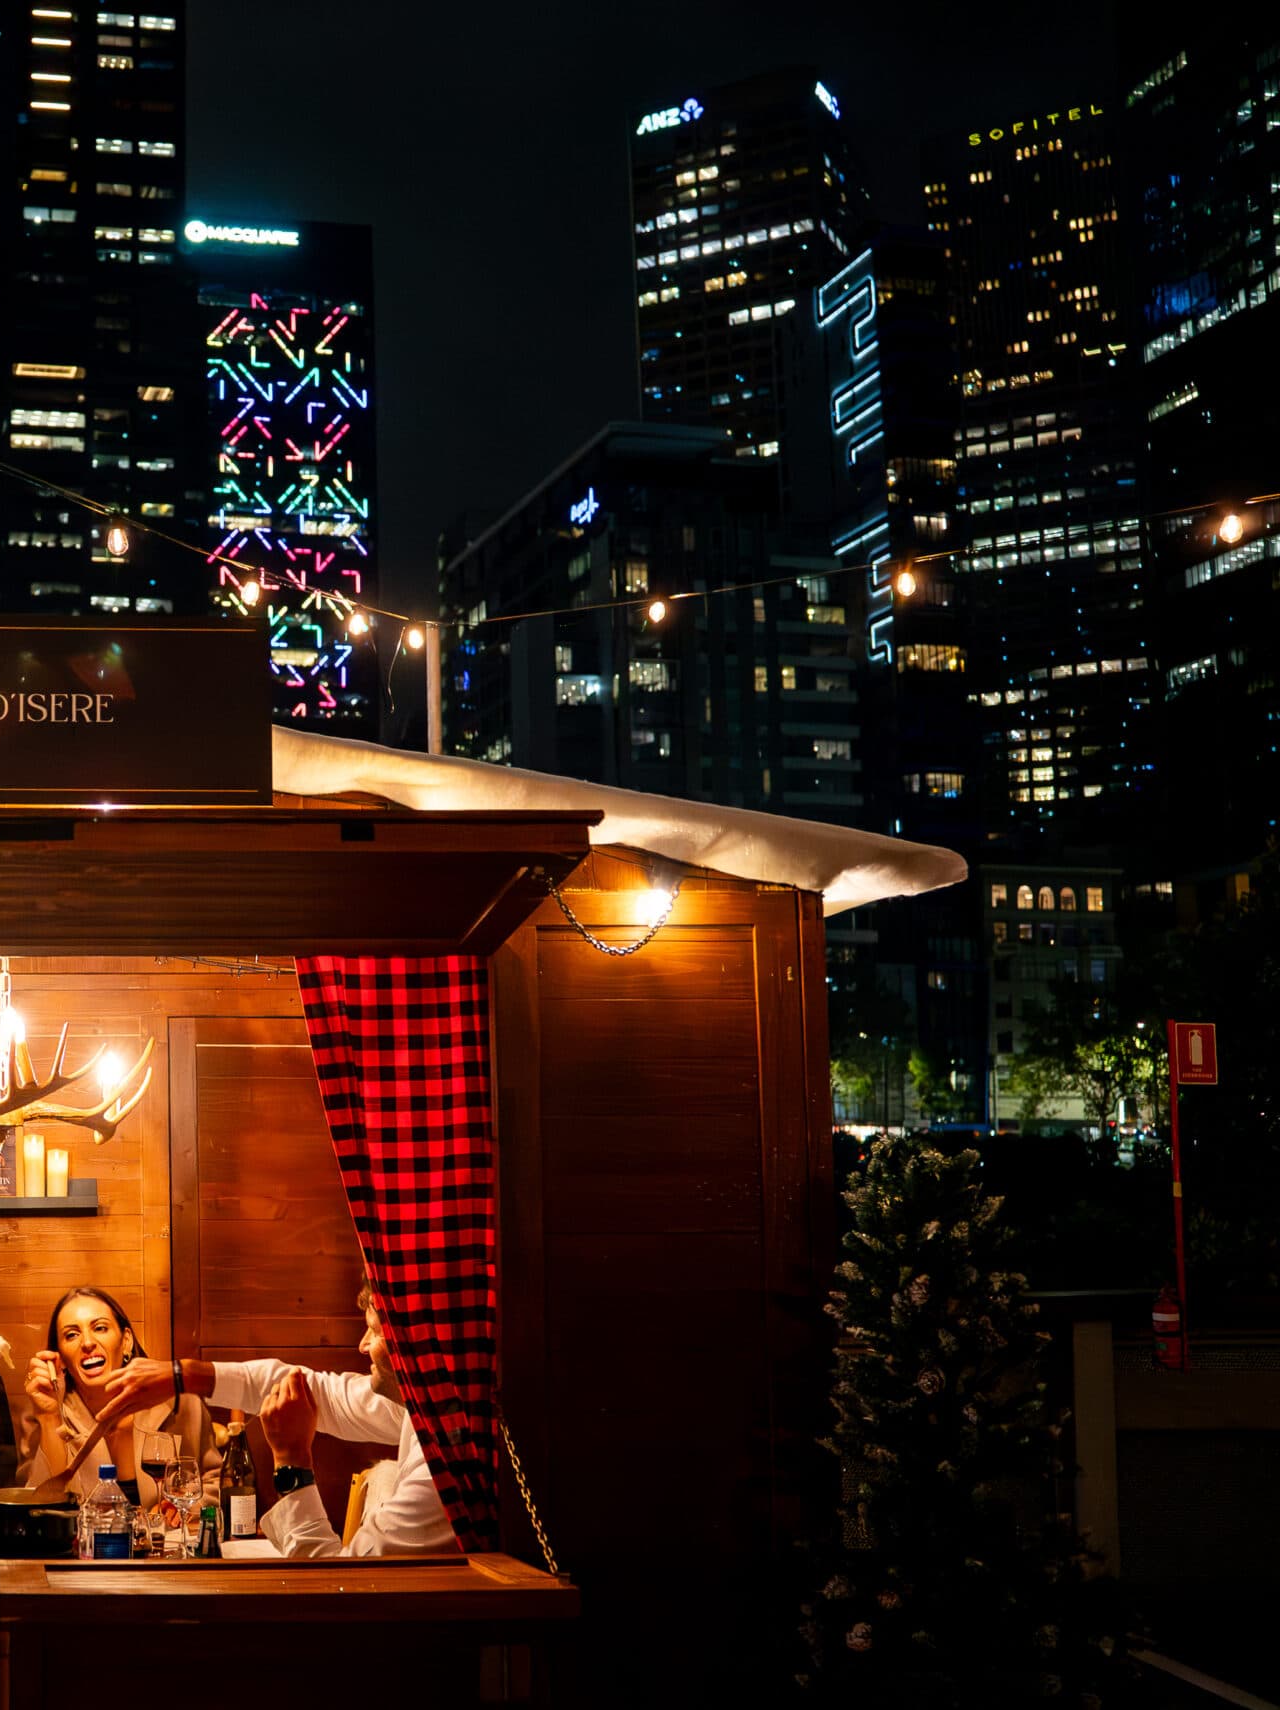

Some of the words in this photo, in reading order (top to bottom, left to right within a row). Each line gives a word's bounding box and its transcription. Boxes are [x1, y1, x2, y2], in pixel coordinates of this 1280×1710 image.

[636, 107, 681, 136] ANZ
[968, 104, 1104, 146] SOFITEL
[208, 225, 299, 246] MACQUARIE
